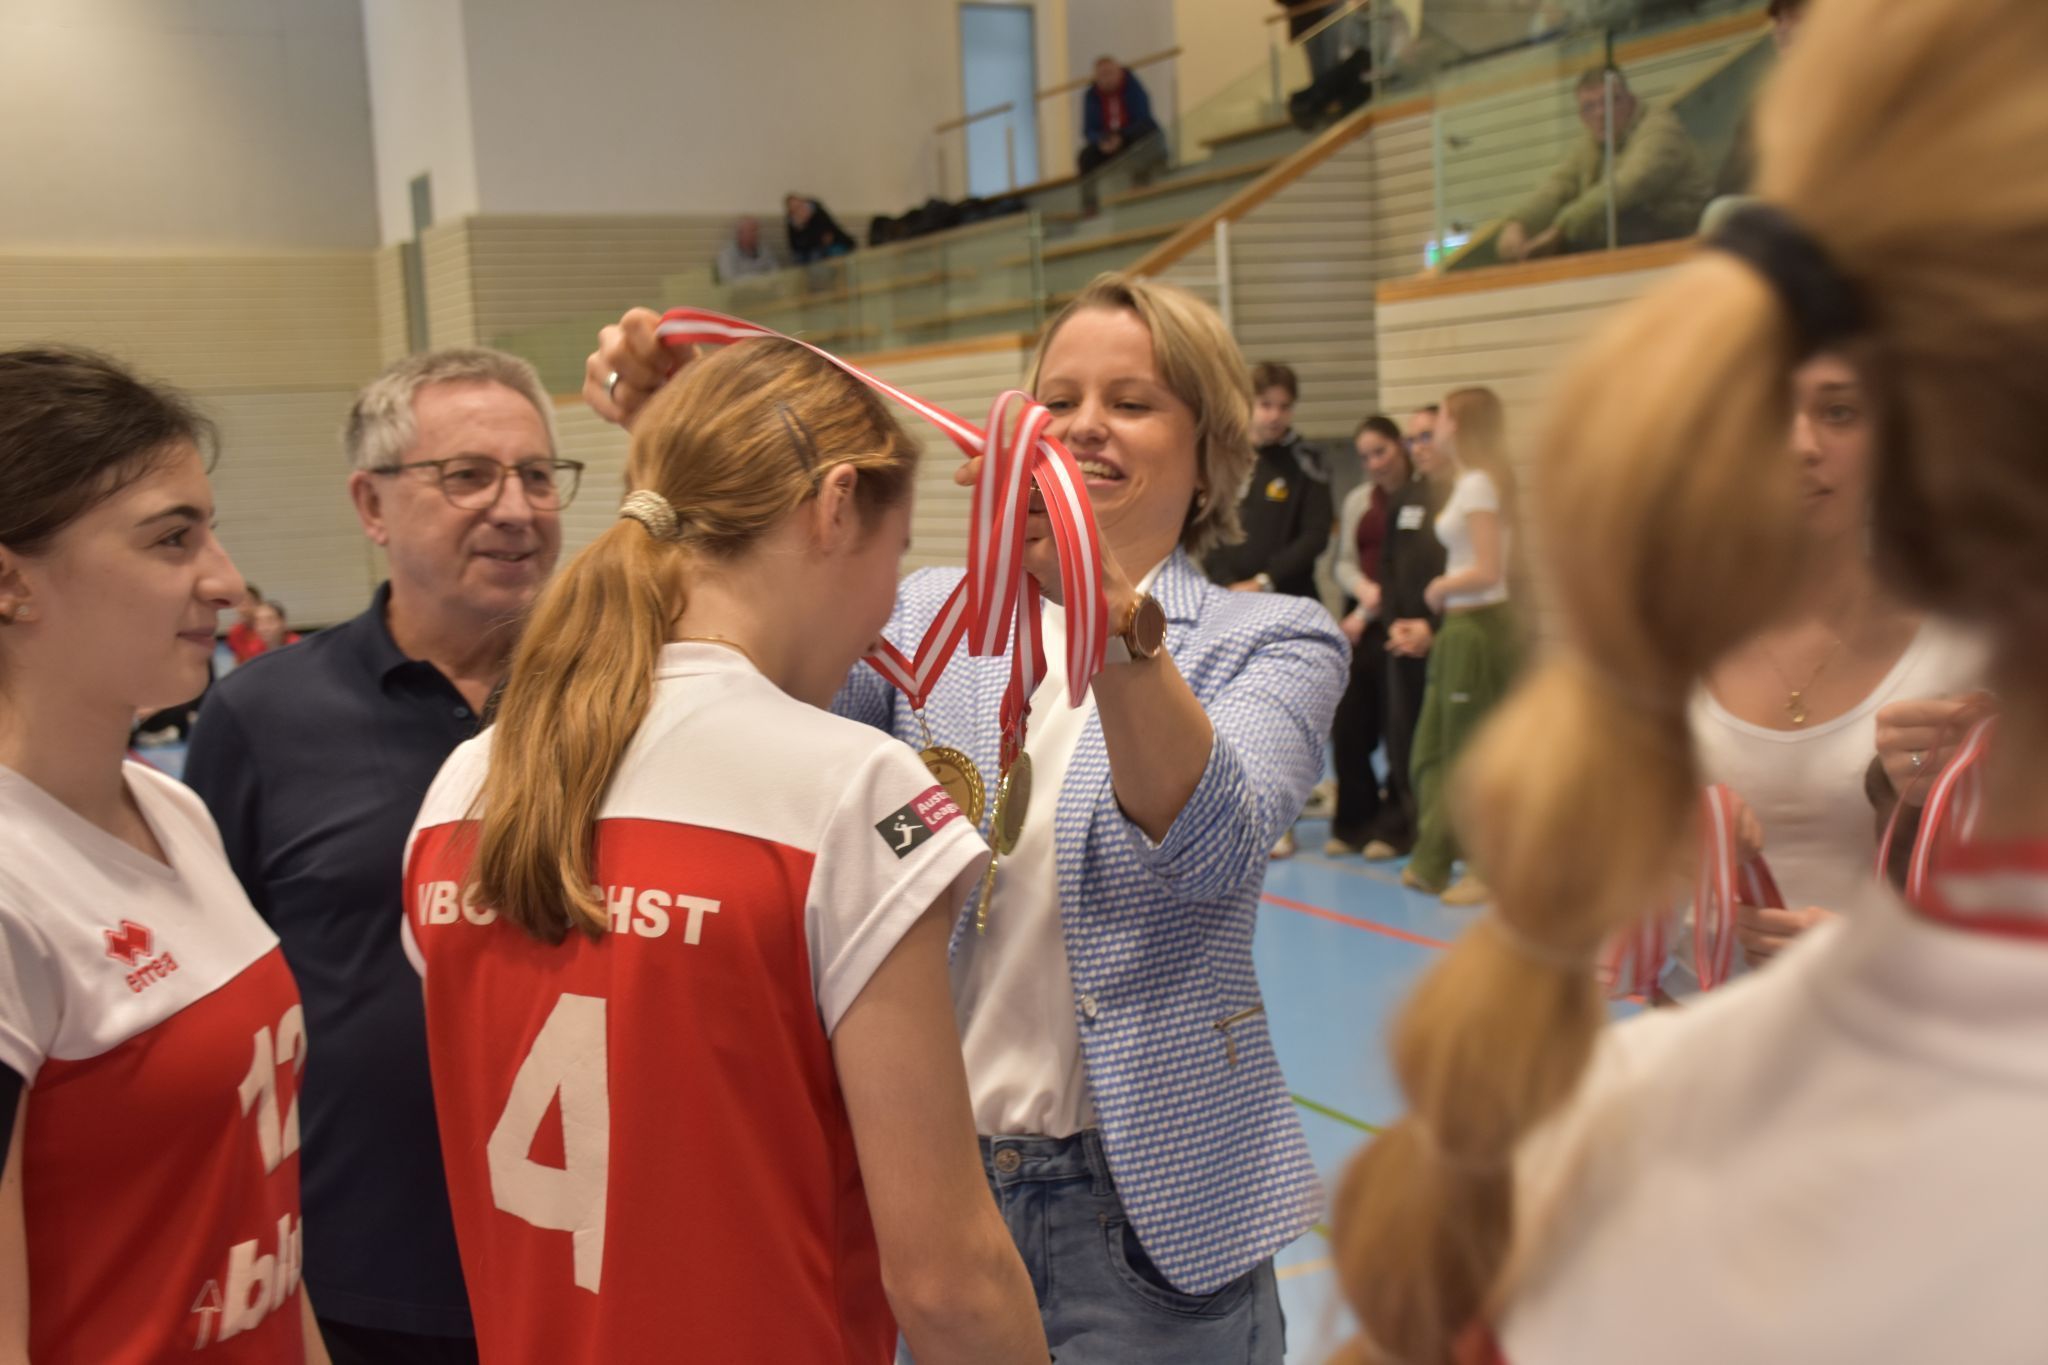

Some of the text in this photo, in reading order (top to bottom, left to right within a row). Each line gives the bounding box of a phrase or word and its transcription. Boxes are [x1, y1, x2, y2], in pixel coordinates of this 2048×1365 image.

[925, 803, 960, 826] Leag
[237, 1003, 308, 1176] 12
[486, 992, 610, 1295] 4
